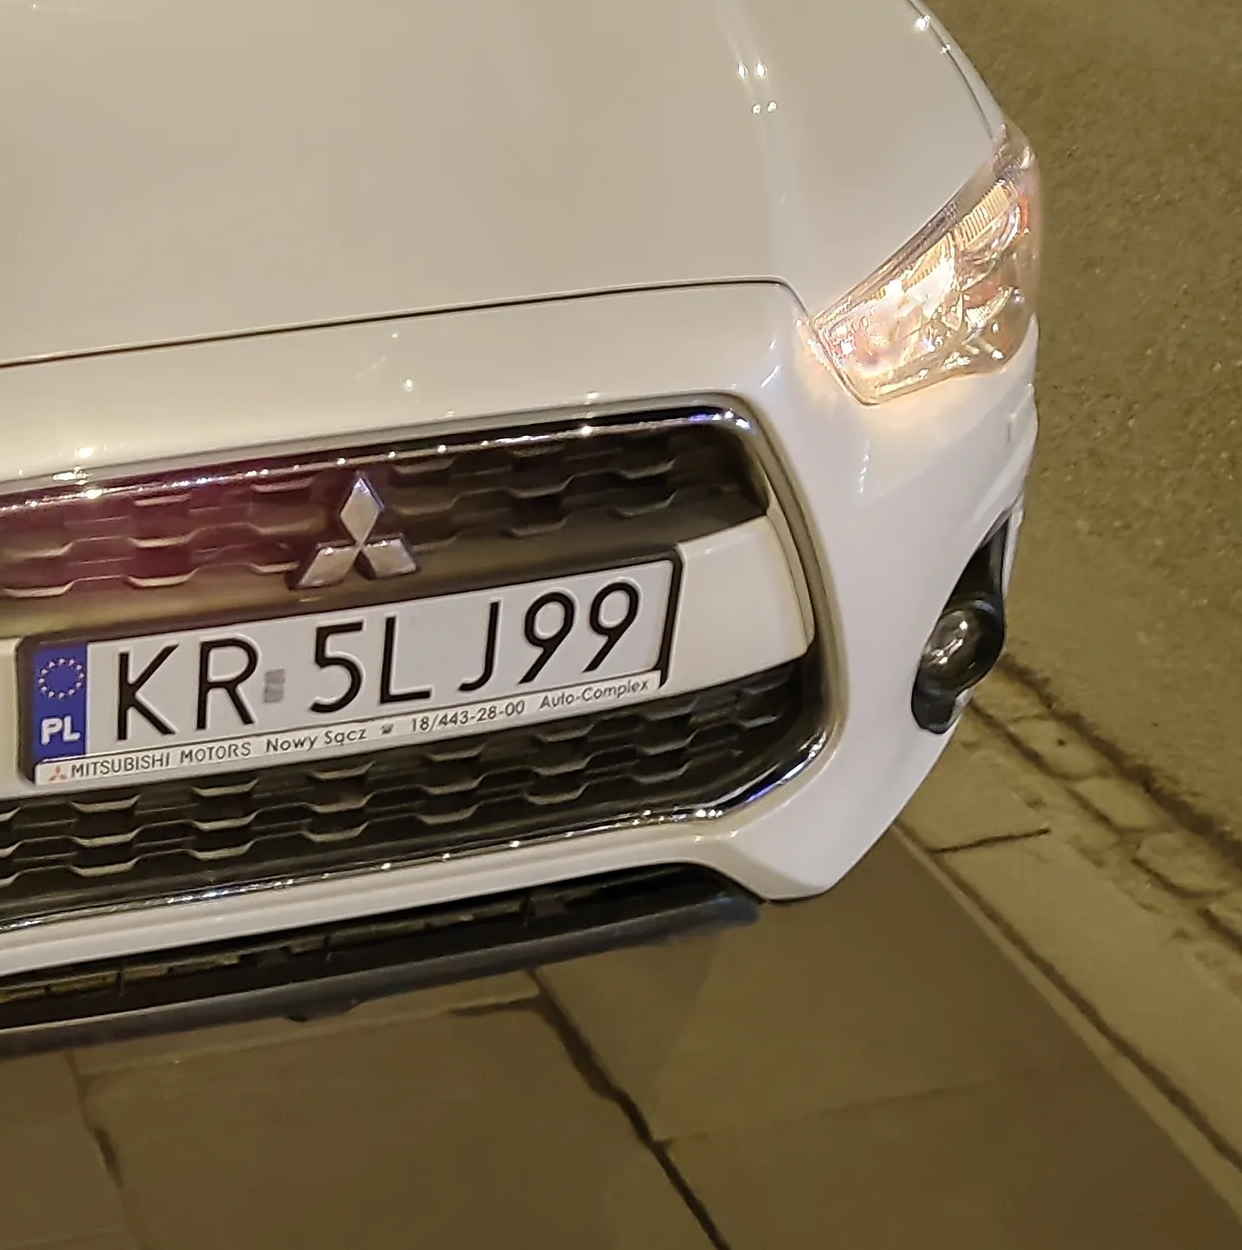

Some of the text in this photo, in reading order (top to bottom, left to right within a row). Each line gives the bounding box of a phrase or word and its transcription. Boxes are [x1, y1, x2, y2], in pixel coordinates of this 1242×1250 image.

[116, 581, 640, 741] KR 5LJ99
[40, 715, 81, 746] PL
[71, 751, 171, 779] MITSUBISHI
[179, 741, 252, 765] MOTORS
[265, 731, 318, 753] Nowy
[410, 699, 526, 734] 18/443-28-00
[539, 677, 650, 710] Auto-Complex
